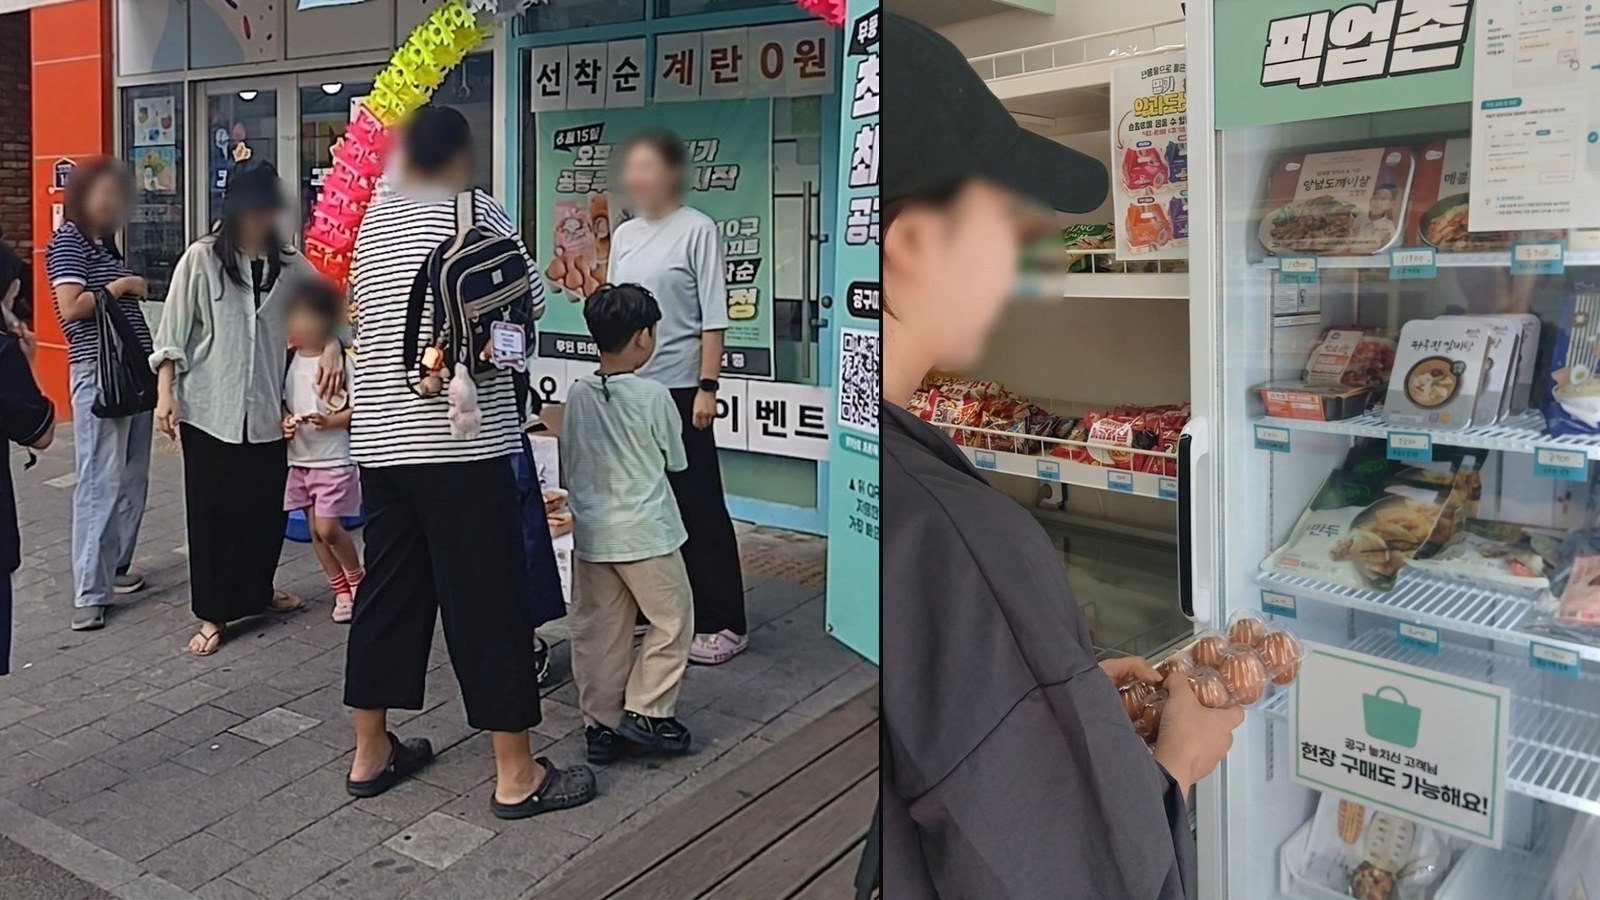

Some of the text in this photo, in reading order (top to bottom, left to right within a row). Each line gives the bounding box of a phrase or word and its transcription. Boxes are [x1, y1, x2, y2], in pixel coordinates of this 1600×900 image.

[536, 38, 827, 97] 선착순 계란 0원
[1261, 0, 1473, 88] 픽업존
[714, 395, 829, 440] 이벤트
[1301, 741, 1488, 816] 현장 구매도 가능해요!
[1345, 737, 1366, 753] 공구
[1404, 755, 1438, 776] 고객님
